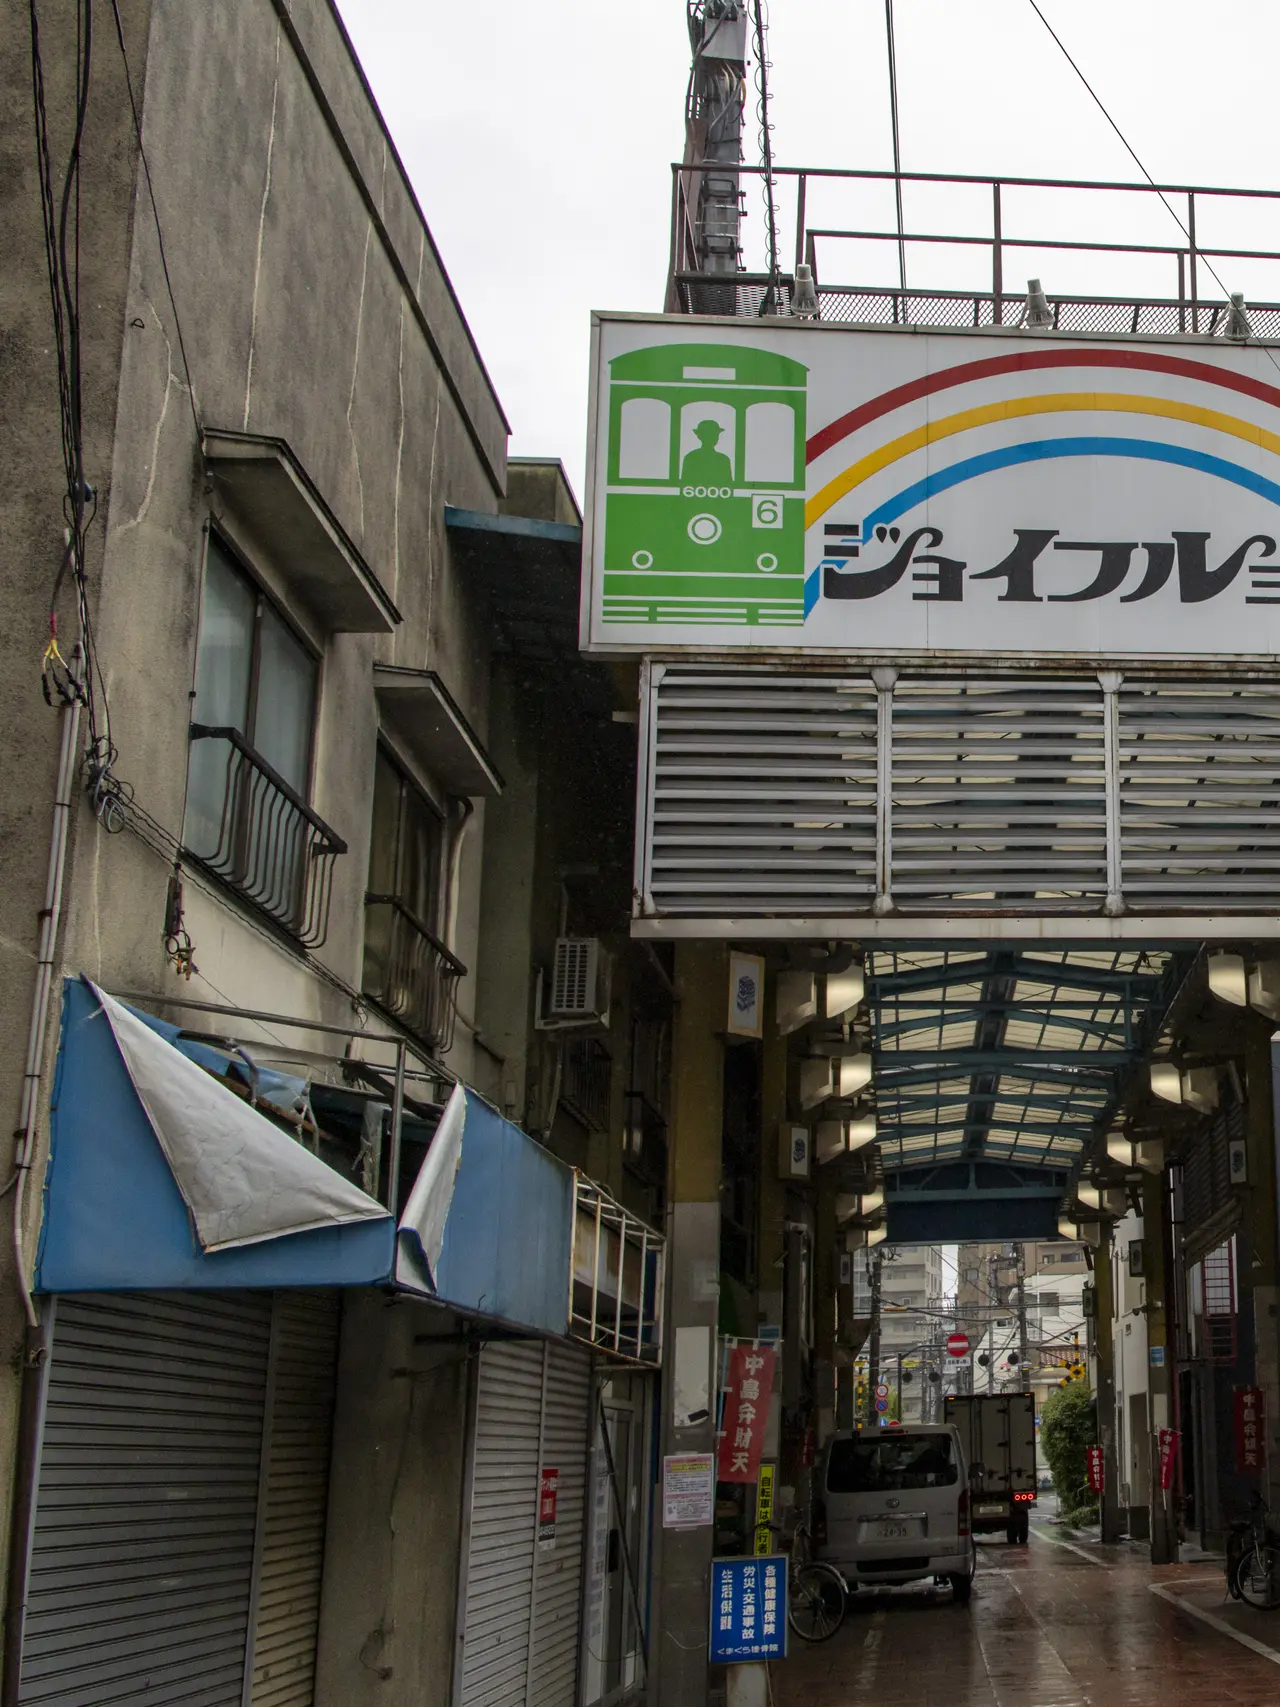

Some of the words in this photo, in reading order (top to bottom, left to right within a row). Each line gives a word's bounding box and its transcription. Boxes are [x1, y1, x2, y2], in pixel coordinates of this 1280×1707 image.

[682, 486, 731, 498] 6000
[757, 500, 778, 525] 6
[730, 1354, 764, 1473] 中島弁財天
[720, 1568, 733, 1631] 生活保護
[764, 1564, 776, 1636] 各種健康保険
